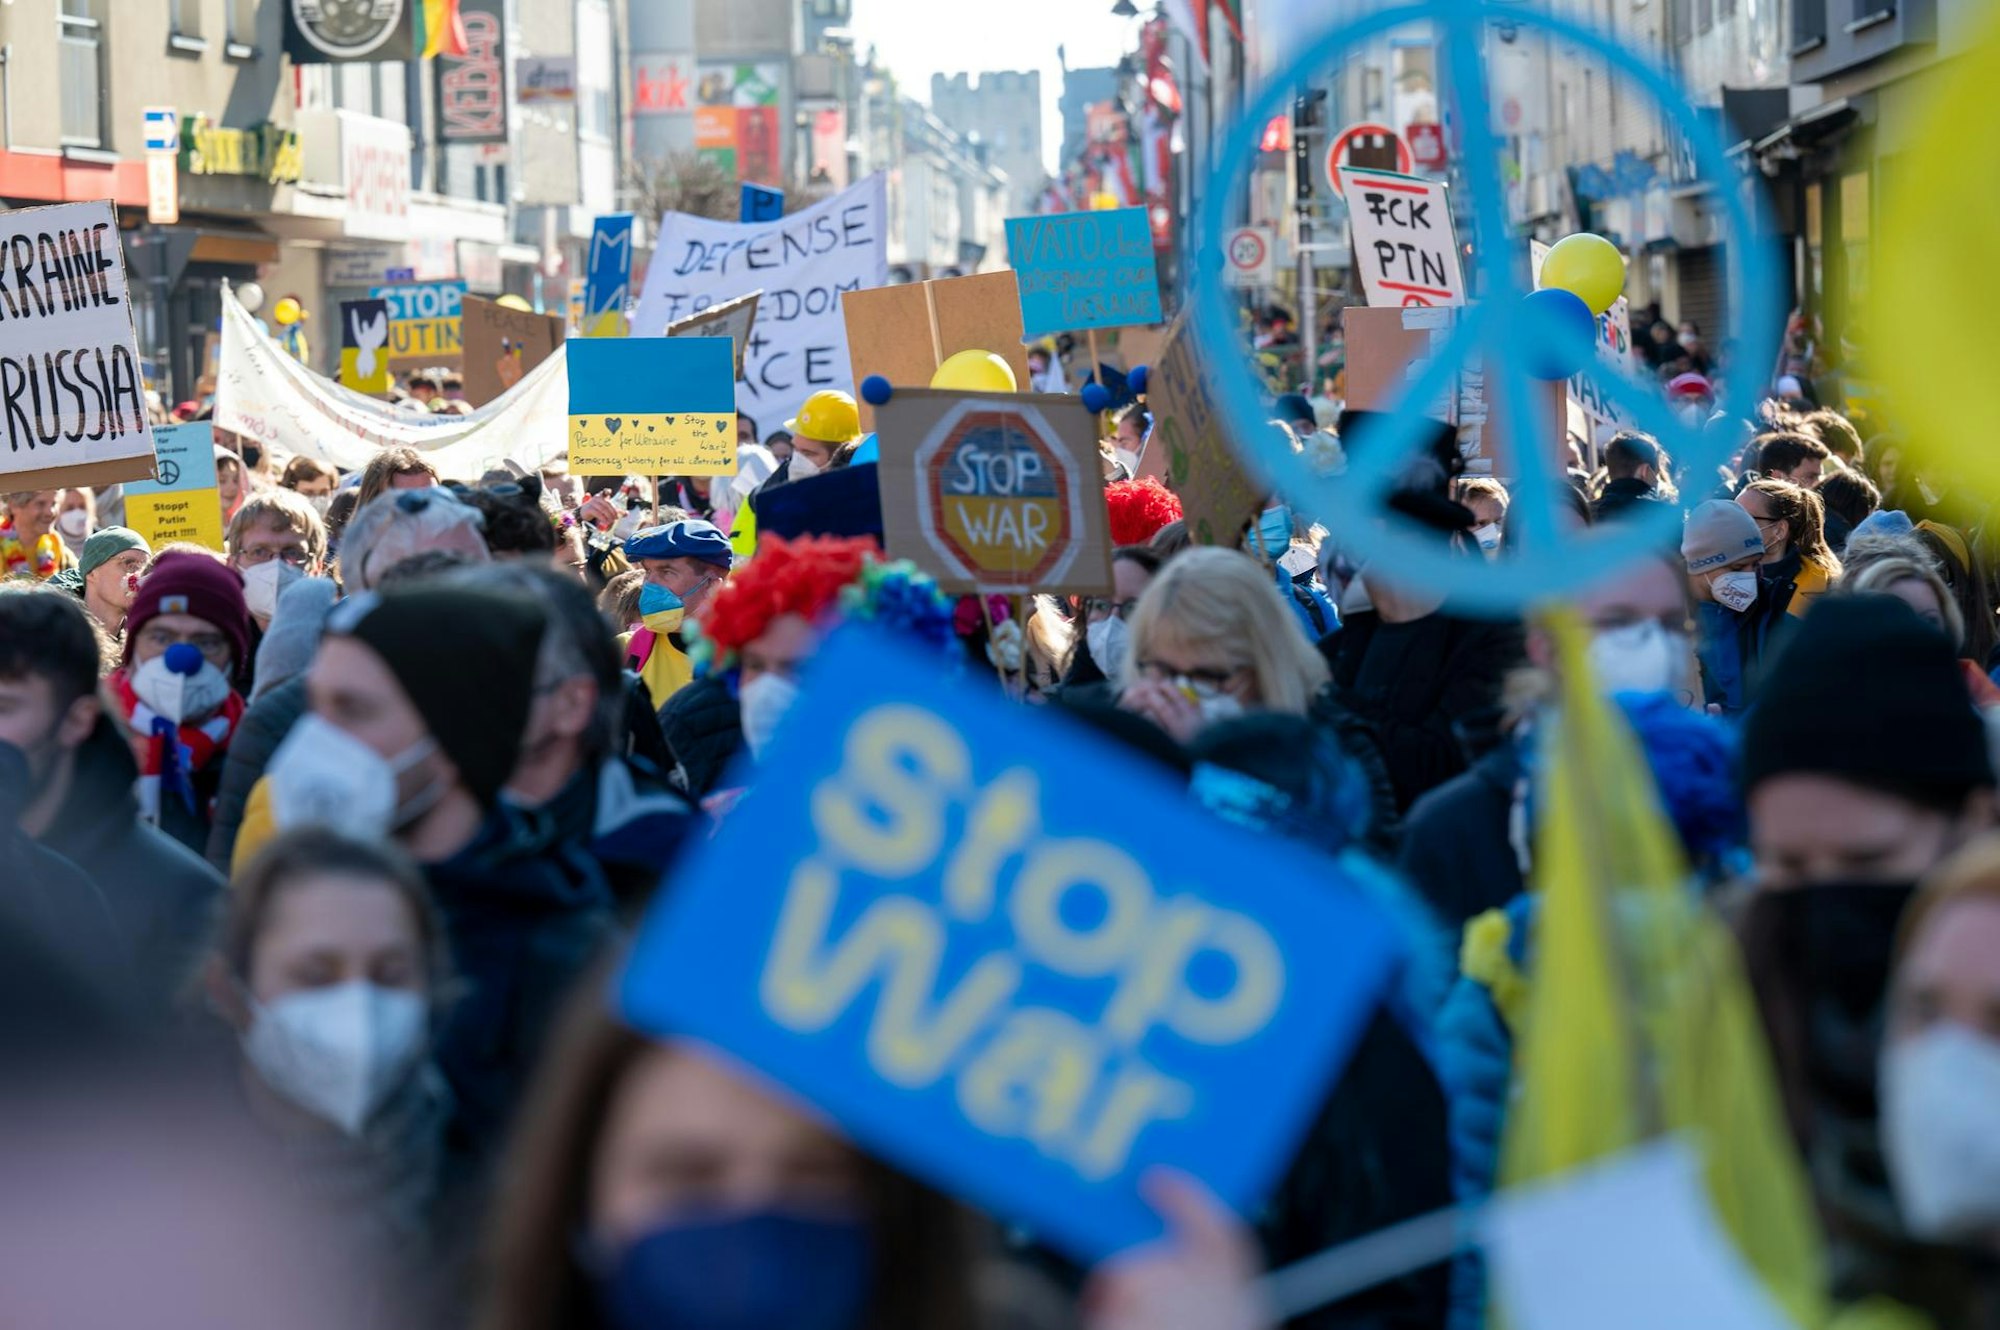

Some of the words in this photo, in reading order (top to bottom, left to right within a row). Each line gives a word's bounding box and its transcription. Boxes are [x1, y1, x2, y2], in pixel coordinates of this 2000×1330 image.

[1013, 216, 1100, 264] NATO
[1373, 240, 1446, 286] PTN
[377, 285, 461, 319] STOP
[392, 320, 463, 353] UTIN
[0, 344, 143, 452] RUSSIA
[685, 414, 705, 428] Stop
[574, 431, 611, 449] Peace
[619, 431, 632, 450] for
[634, 432, 677, 447] Ukraine
[660, 456, 669, 467] for
[953, 443, 1042, 495] STOP
[153, 502, 189, 511] Stoppt
[158, 516, 187, 524] Putin
[153, 531, 178, 540] jetzt
[956, 502, 1048, 555] WAR
[812, 703, 1285, 1047] Stop
[759, 857, 1194, 1181] War
